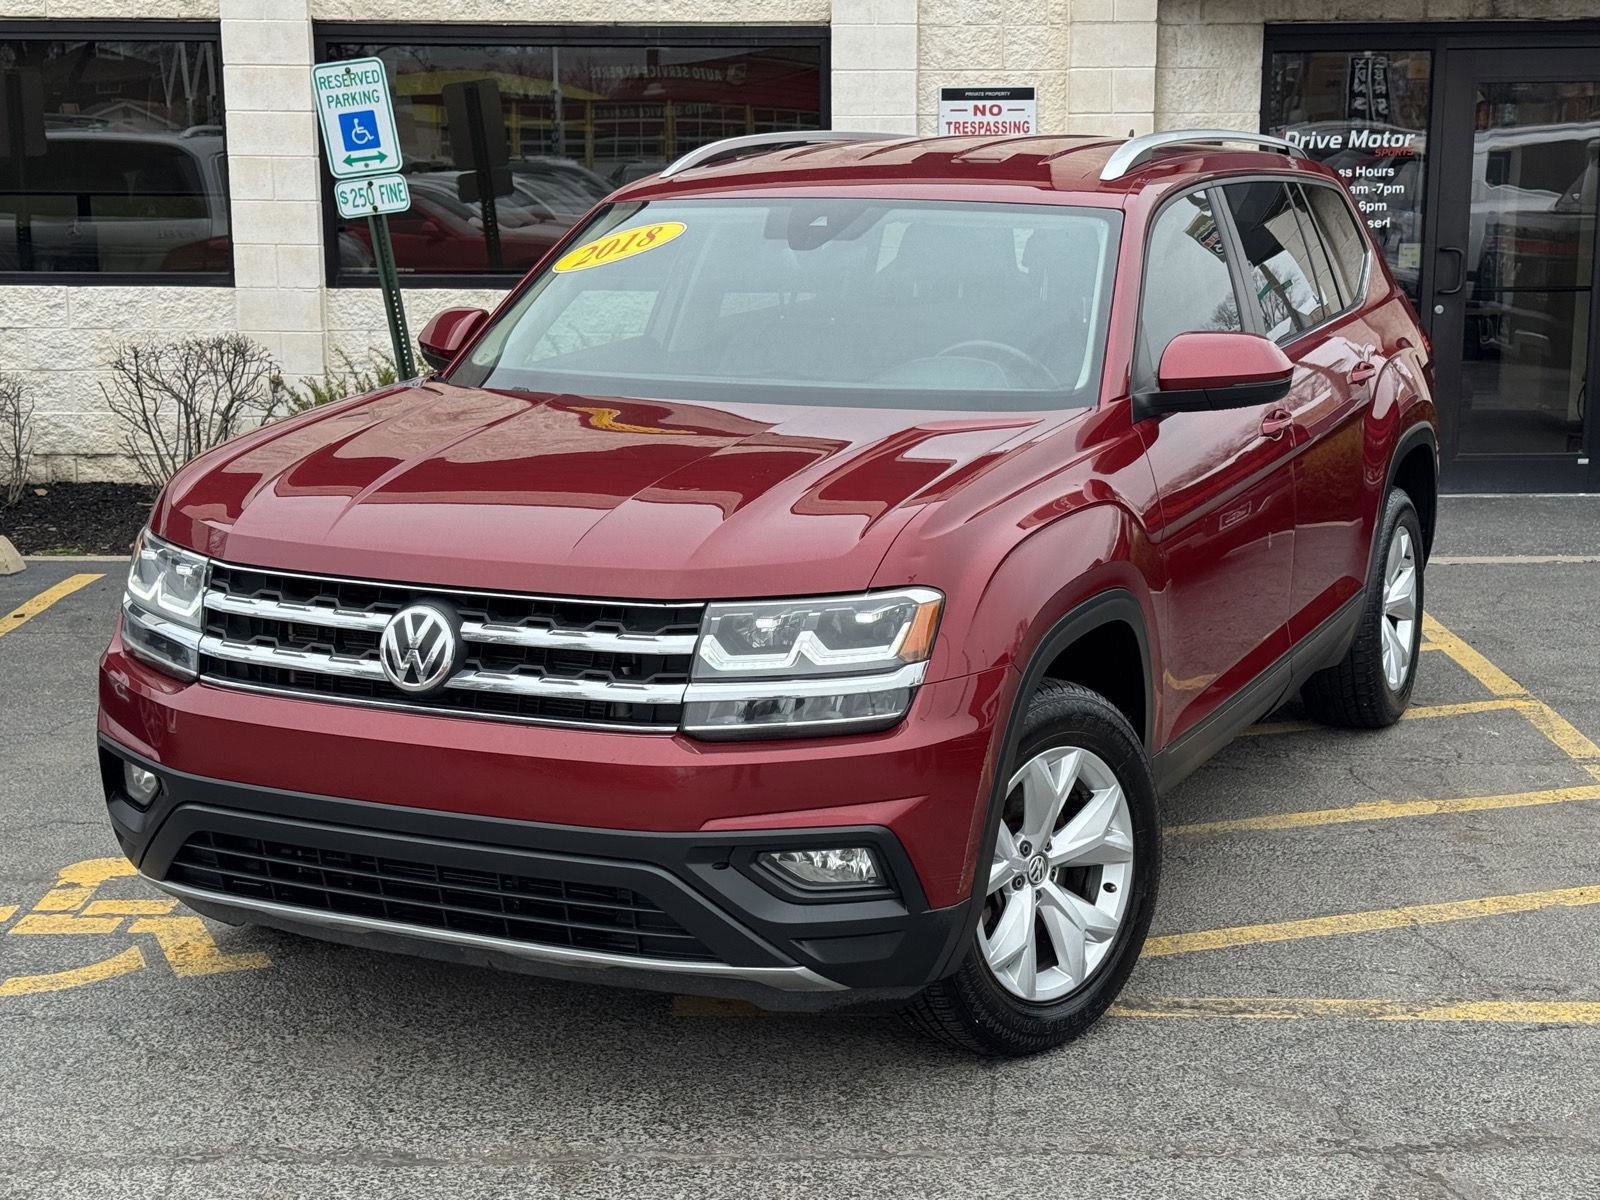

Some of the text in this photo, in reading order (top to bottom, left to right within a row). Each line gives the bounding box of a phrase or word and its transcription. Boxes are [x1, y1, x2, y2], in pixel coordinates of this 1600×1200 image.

[318, 69, 380, 91] RESERVED
[326, 89, 380, 109] PARKING
[973, 104, 1003, 117] NO
[945, 120, 1030, 135] TRESPASSING
[1348, 130, 1416, 149] Motor
[1355, 166, 1395, 177] Hours
[340, 182, 406, 208] $250 FINE
[571, 226, 664, 268] 2018
